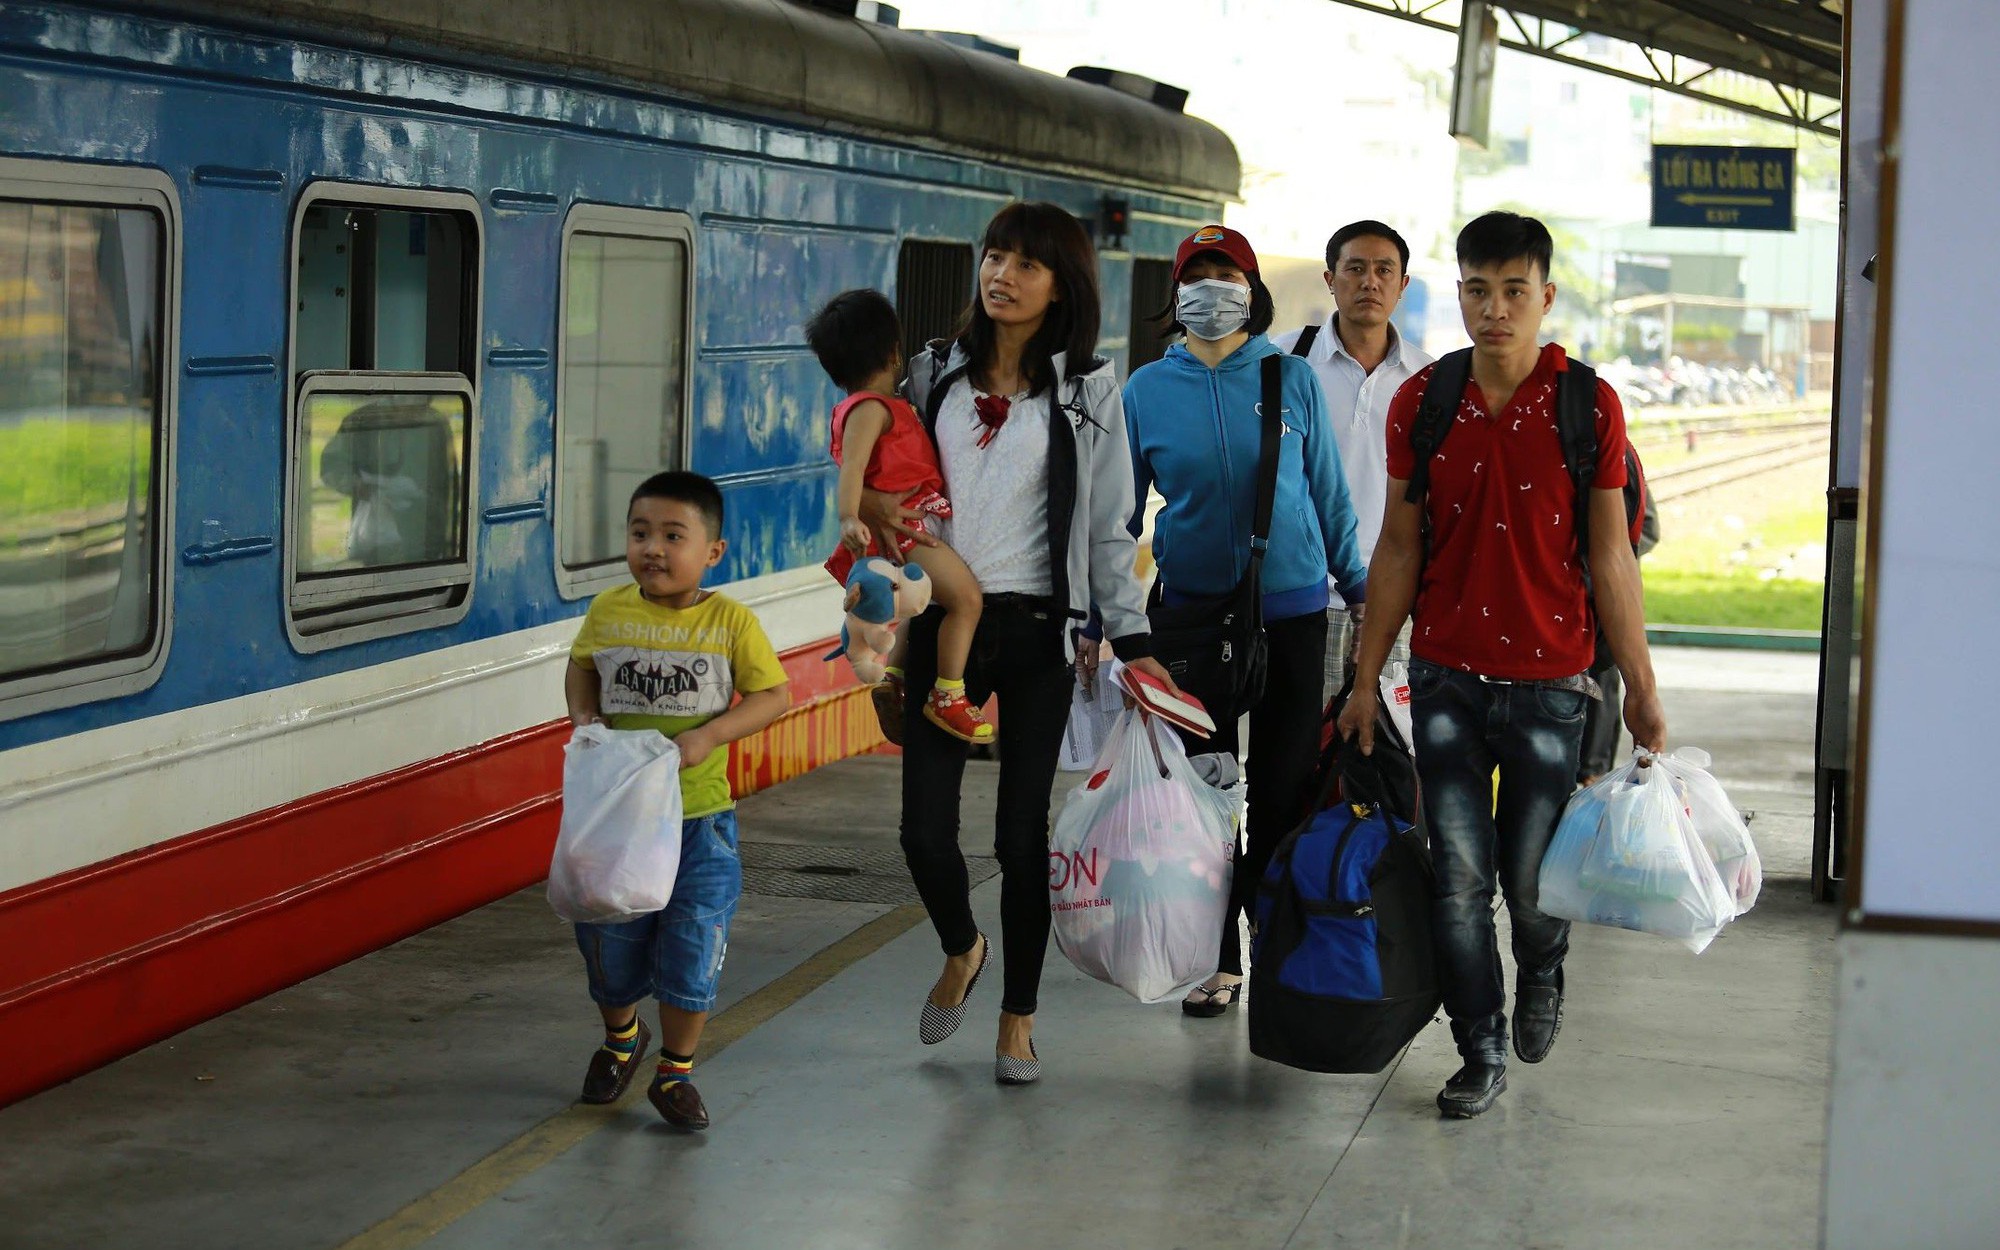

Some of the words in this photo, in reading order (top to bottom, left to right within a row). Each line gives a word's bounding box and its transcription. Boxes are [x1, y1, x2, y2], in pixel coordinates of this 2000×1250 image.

[1692, 158, 1713, 188] RA
[1763, 161, 1785, 190] GA
[1706, 209, 1740, 222] EXIT
[658, 704, 698, 713] KNIGHT
